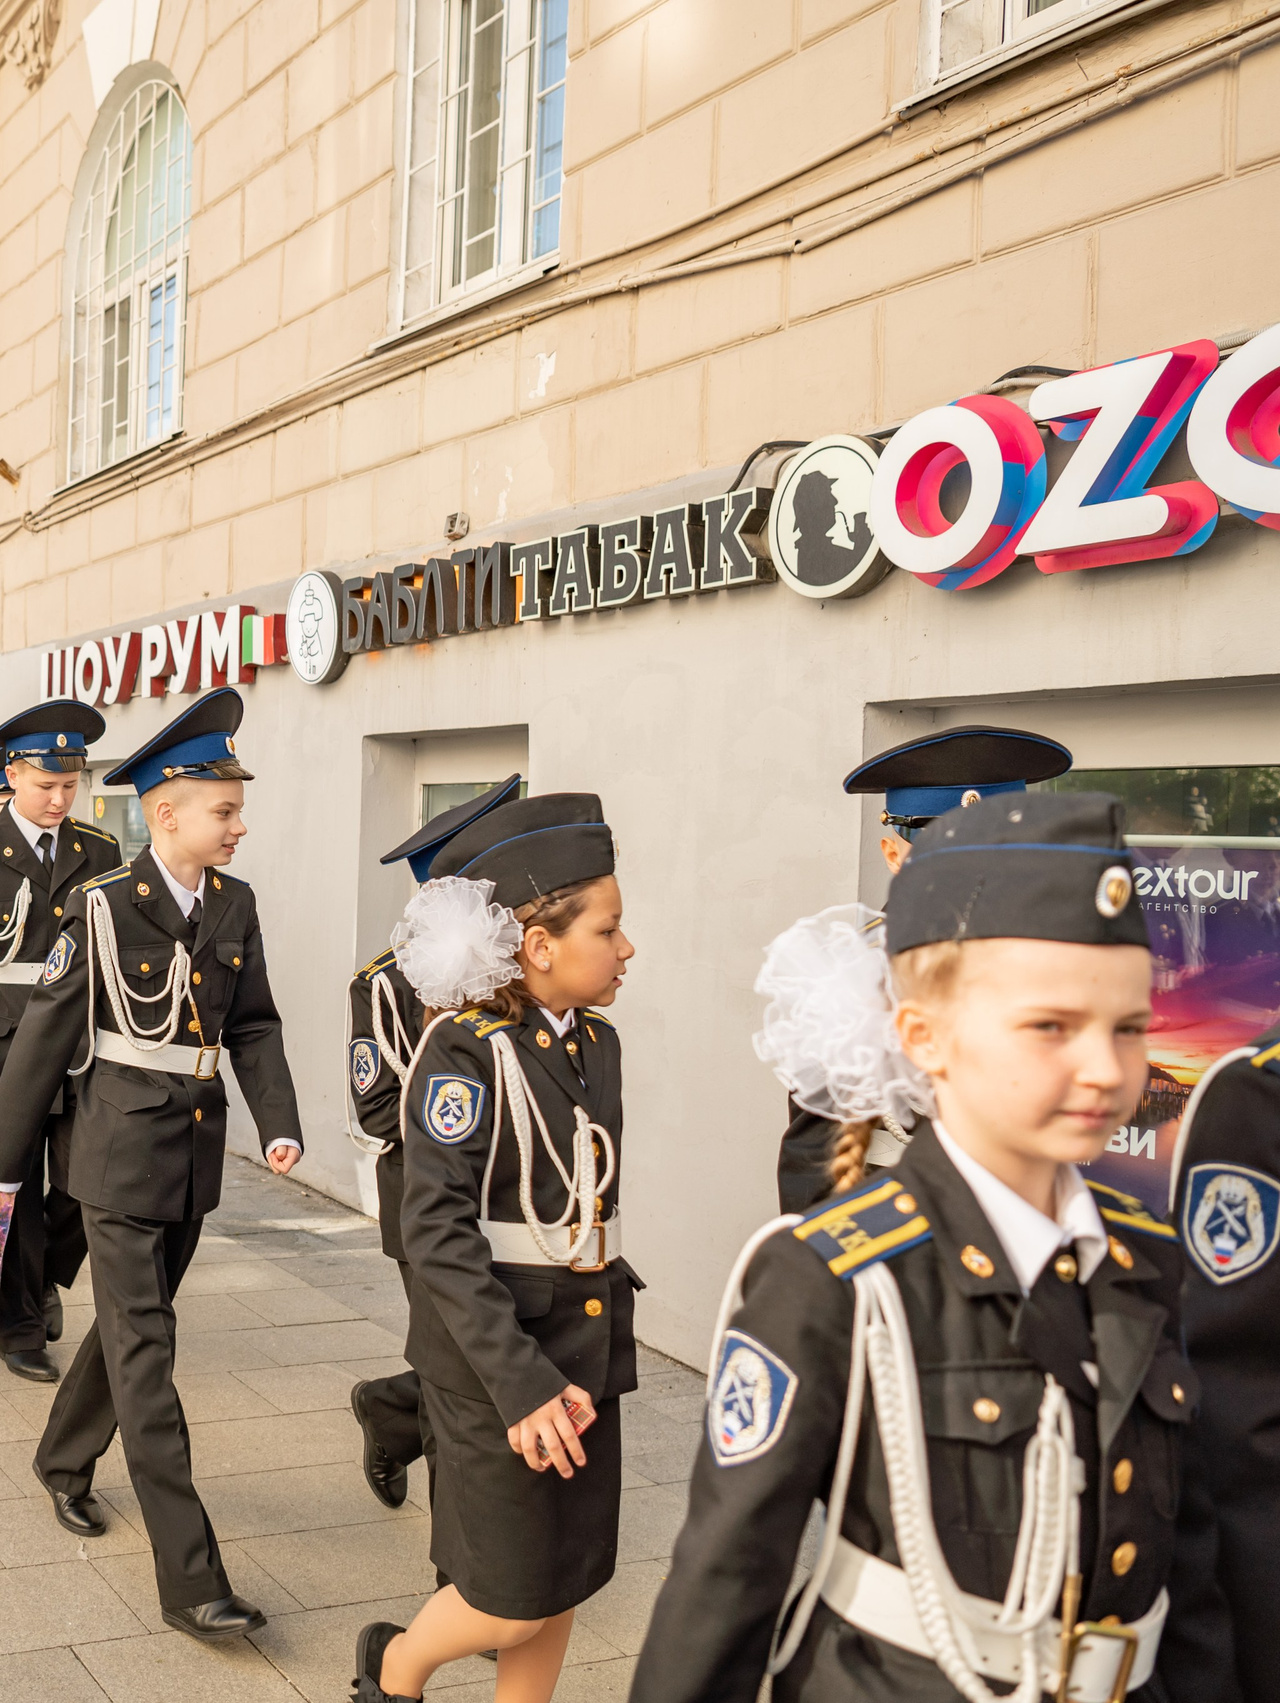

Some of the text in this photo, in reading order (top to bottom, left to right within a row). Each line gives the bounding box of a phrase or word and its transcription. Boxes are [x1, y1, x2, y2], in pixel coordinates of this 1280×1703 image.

[510, 486, 760, 621] ТАБАК
[40, 604, 246, 708] ШОУ РУМ
[1132, 865, 1259, 900] extour
[1138, 902, 1218, 914] АГЕНТСТВО
[1104, 1125, 1157, 1160] ВИ
